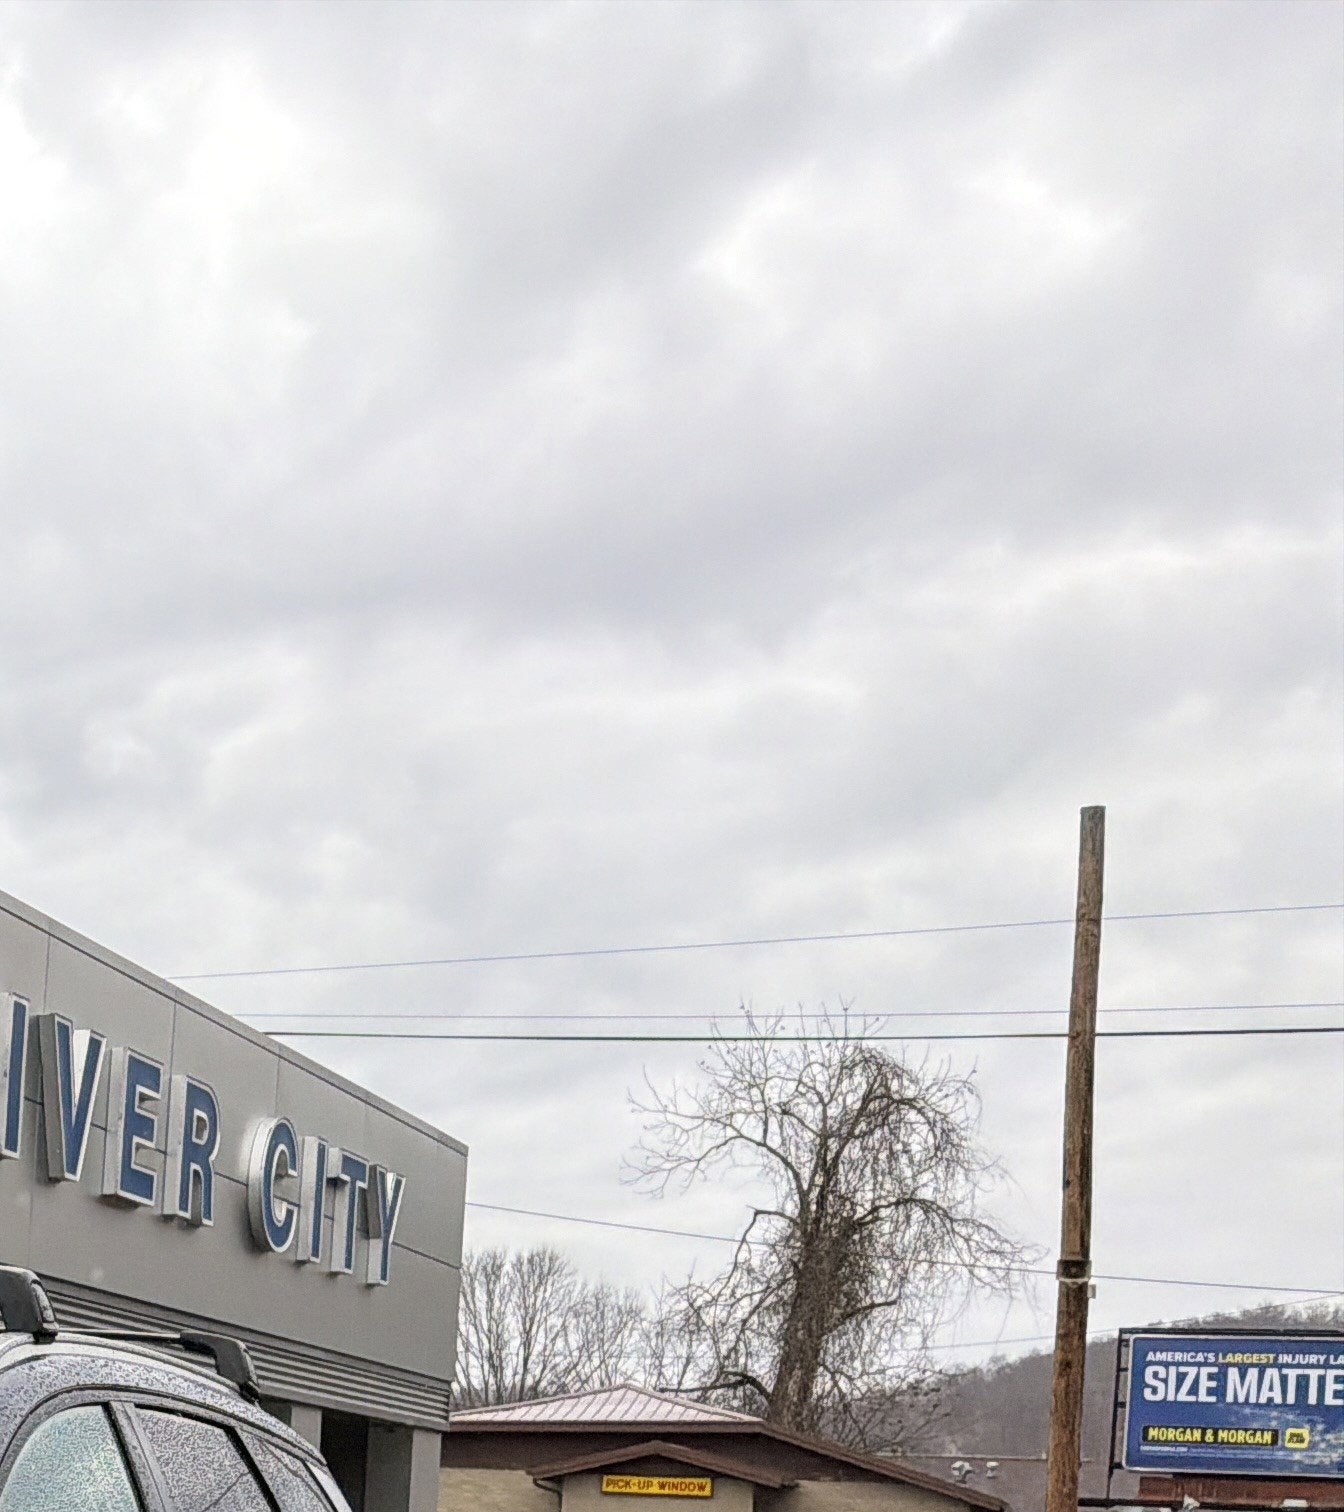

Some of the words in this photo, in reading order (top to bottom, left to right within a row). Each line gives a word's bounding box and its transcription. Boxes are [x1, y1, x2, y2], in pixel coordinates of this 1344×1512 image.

[247, 1117, 407, 1286] CITY
[1145, 1352, 1216, 1363] AMERICA'S
[1218, 1353, 1276, 1365] LARGEST
[1277, 1354, 1327, 1365] INJURY
[1143, 1365, 1219, 1403] SIZE
[1225, 1367, 1344, 1406] MATTE
[1148, 1426, 1202, 1442] MORGAN
[1205, 1428, 1215, 1443] &
[1218, 1429, 1272, 1444] MORGAN
[605, 1478, 654, 1490] PICK-UP
[657, 1480, 707, 1492] WINDOW
